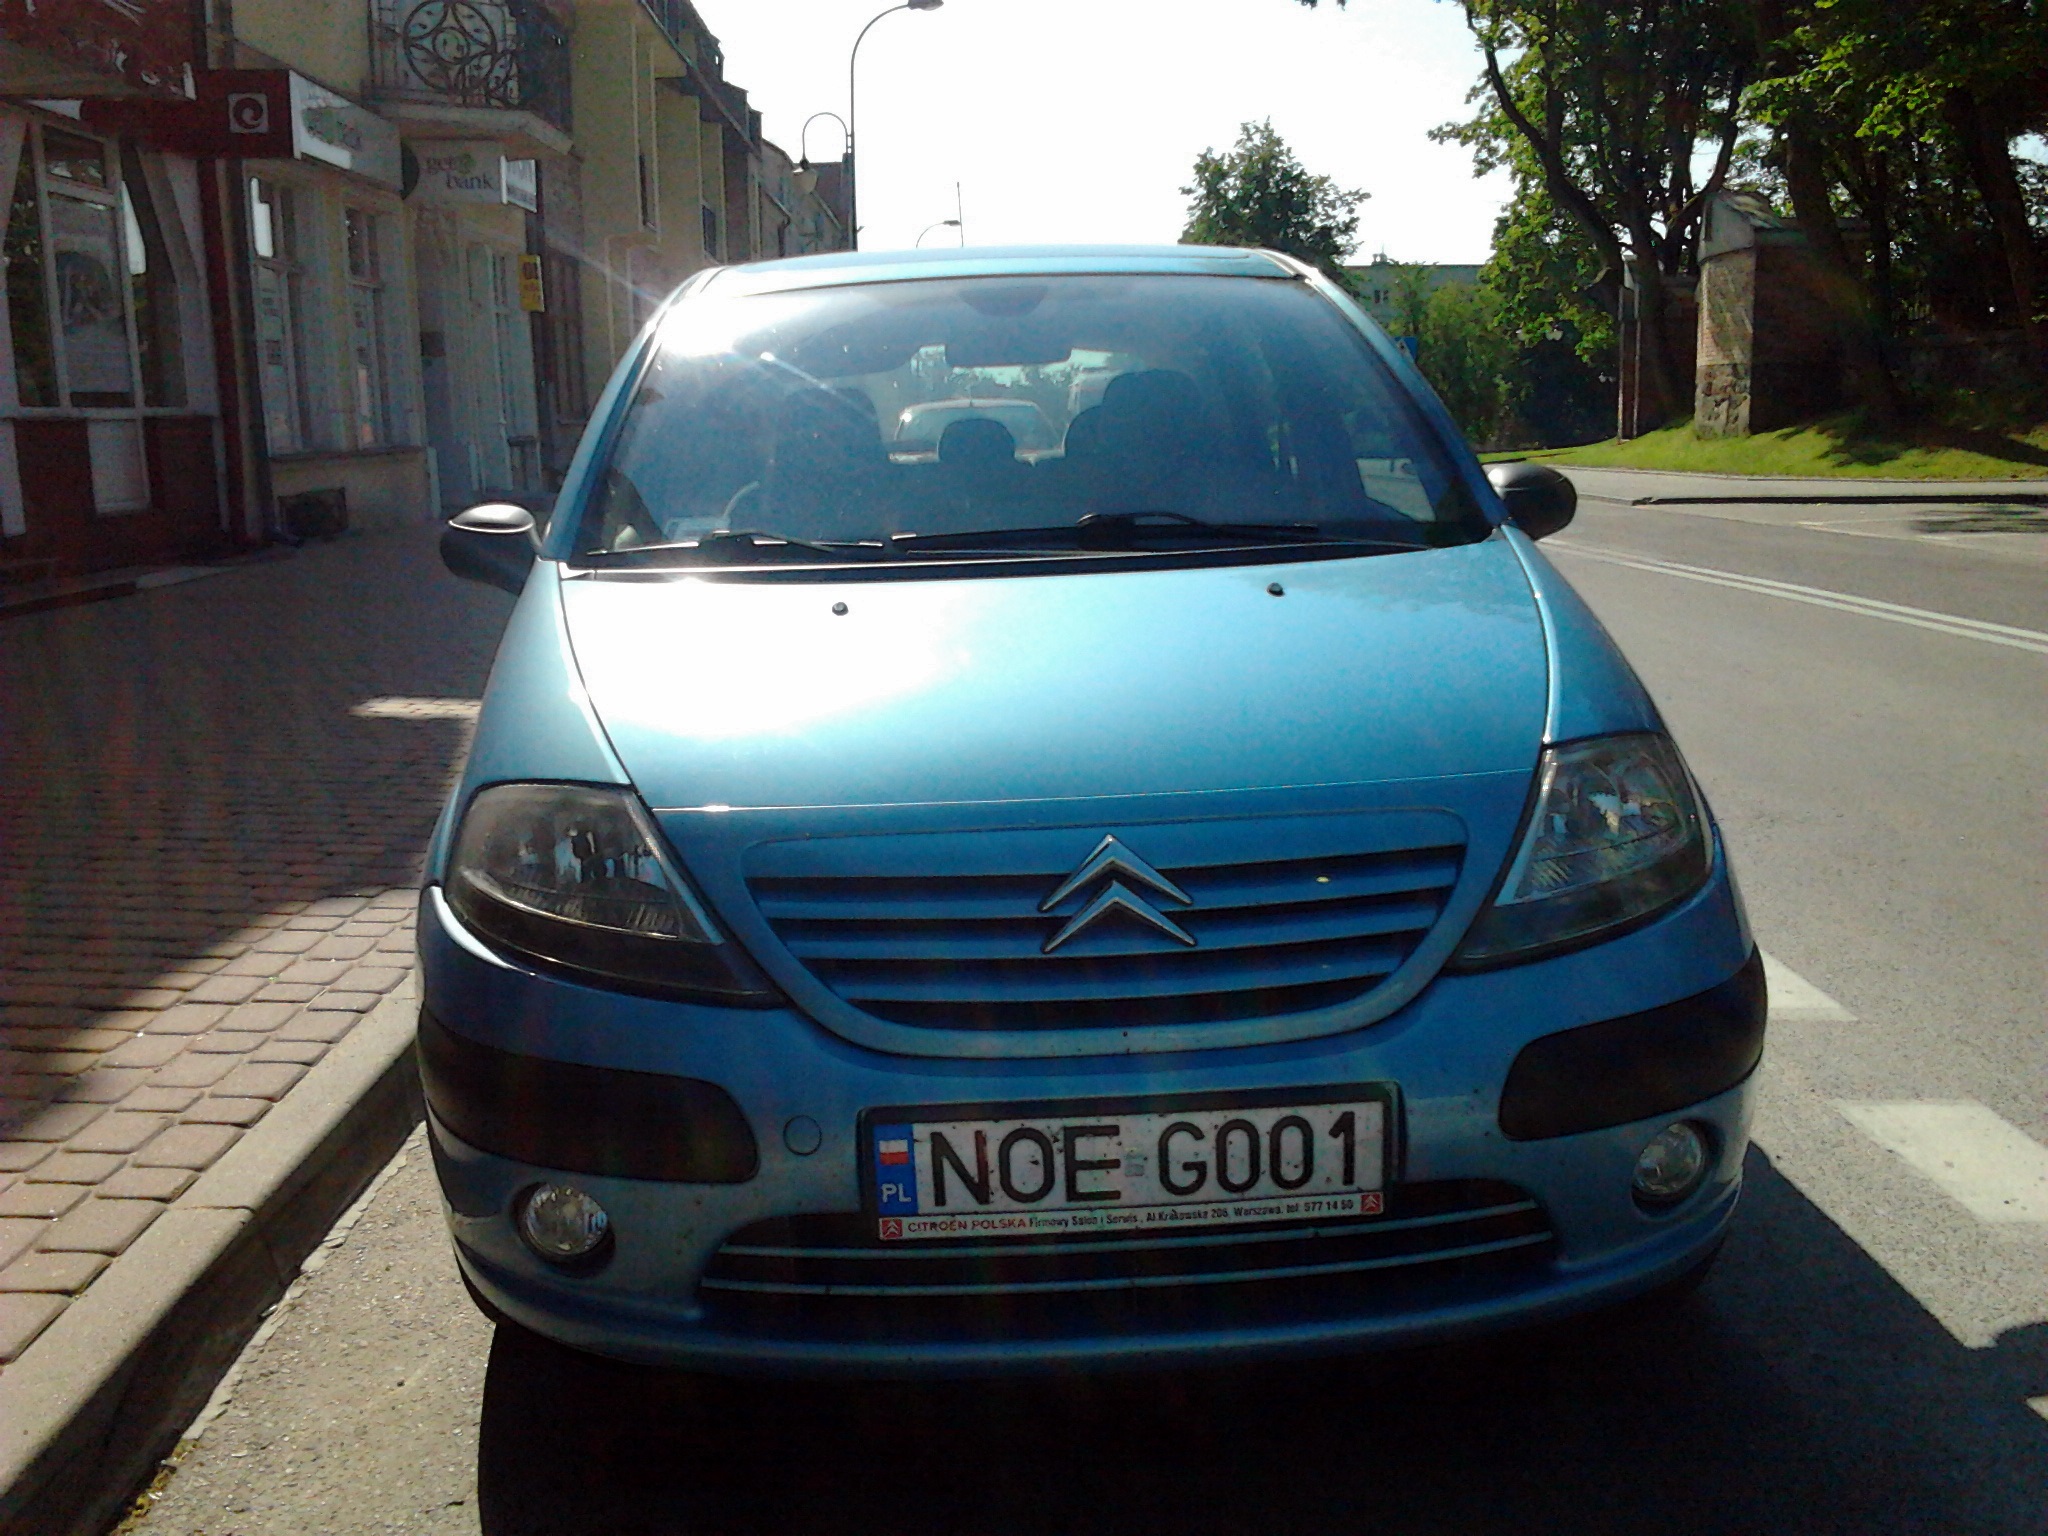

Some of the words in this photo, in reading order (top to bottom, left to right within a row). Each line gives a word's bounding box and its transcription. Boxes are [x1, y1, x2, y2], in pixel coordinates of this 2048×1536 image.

[446, 173, 495, 191] bank
[930, 1124, 1121, 1207] NOE
[1157, 1111, 1356, 1196] G001
[881, 1183, 912, 1203] PL
[971, 1217, 1027, 1231] POLSKA
[1325, 1200, 1338, 1211] 14
